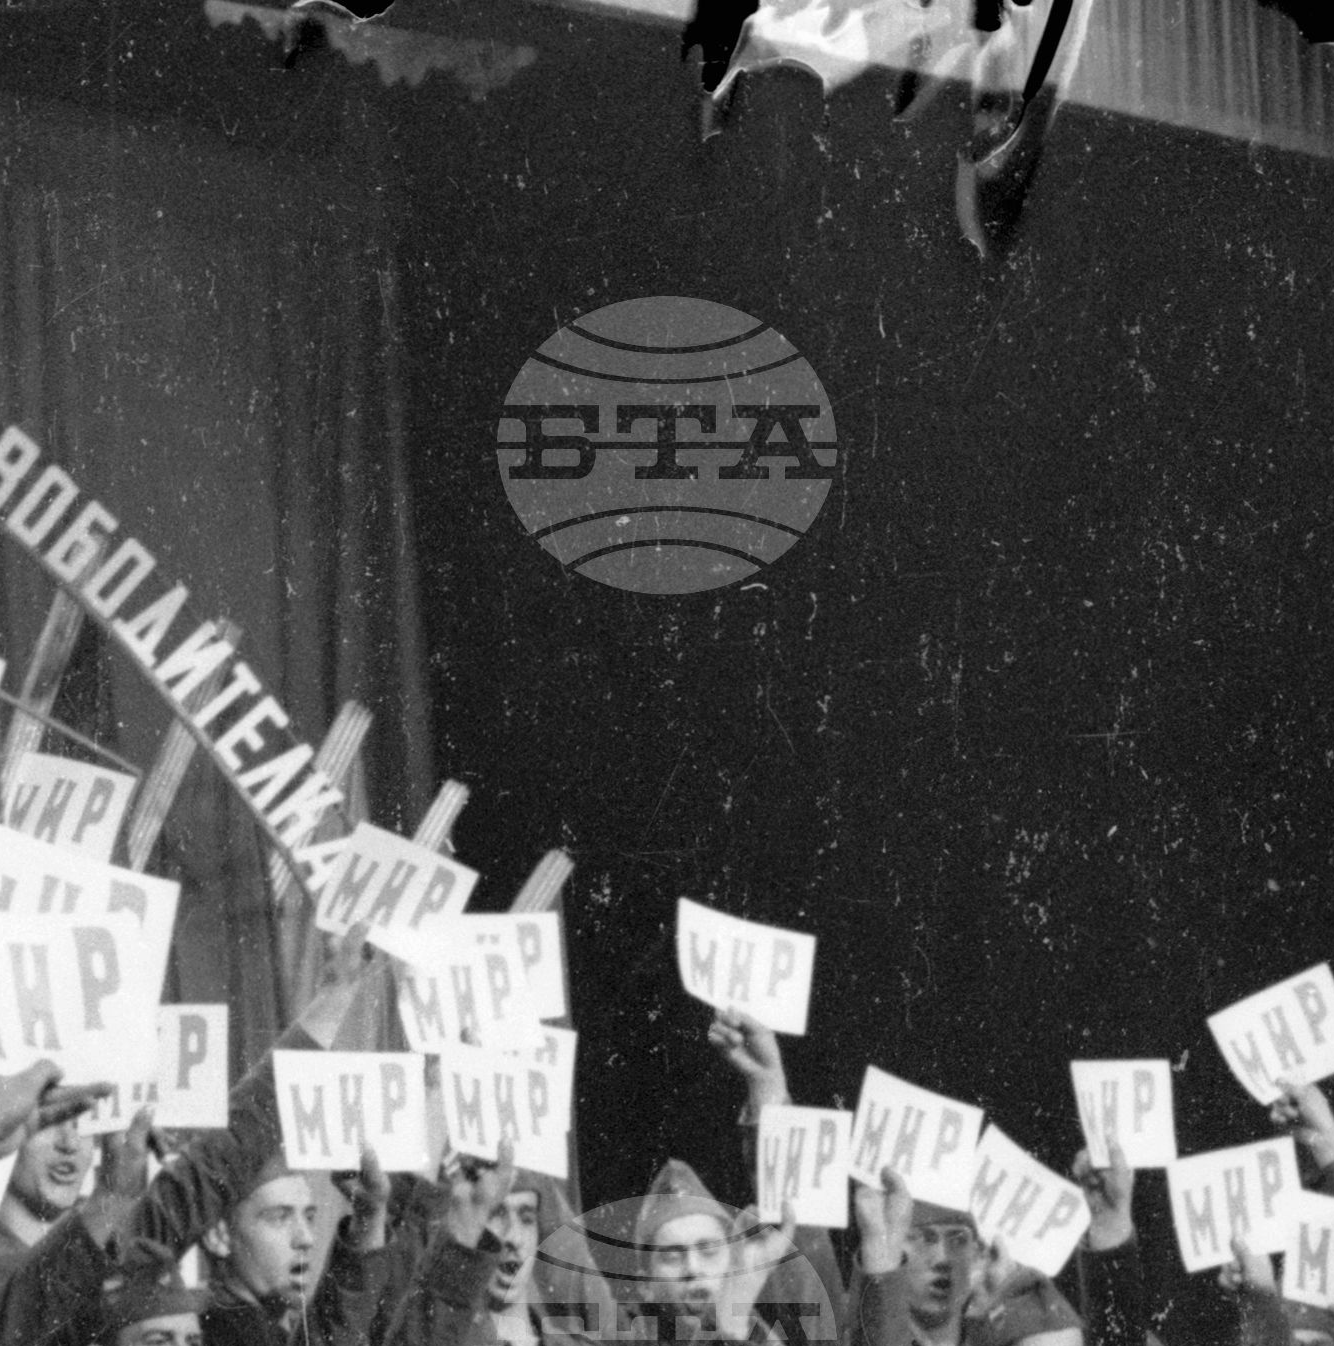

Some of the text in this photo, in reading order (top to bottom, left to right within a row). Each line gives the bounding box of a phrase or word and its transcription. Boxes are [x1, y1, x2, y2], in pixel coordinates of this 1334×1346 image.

[327, 852, 456, 930] МИР
[406, 952, 512, 1048] МИР
[689, 930, 795, 1002] МИР
[1229, 980, 1328, 1098] МИР
[288, 1062, 406, 1158] МИР
[453, 1068, 549, 1146] МИР
[856, 1102, 965, 1175] МИР
[763, 1118, 837, 1212] МИР
[972, 1154, 1081, 1240] МИР
[1183, 1147, 1284, 1257] МИР
